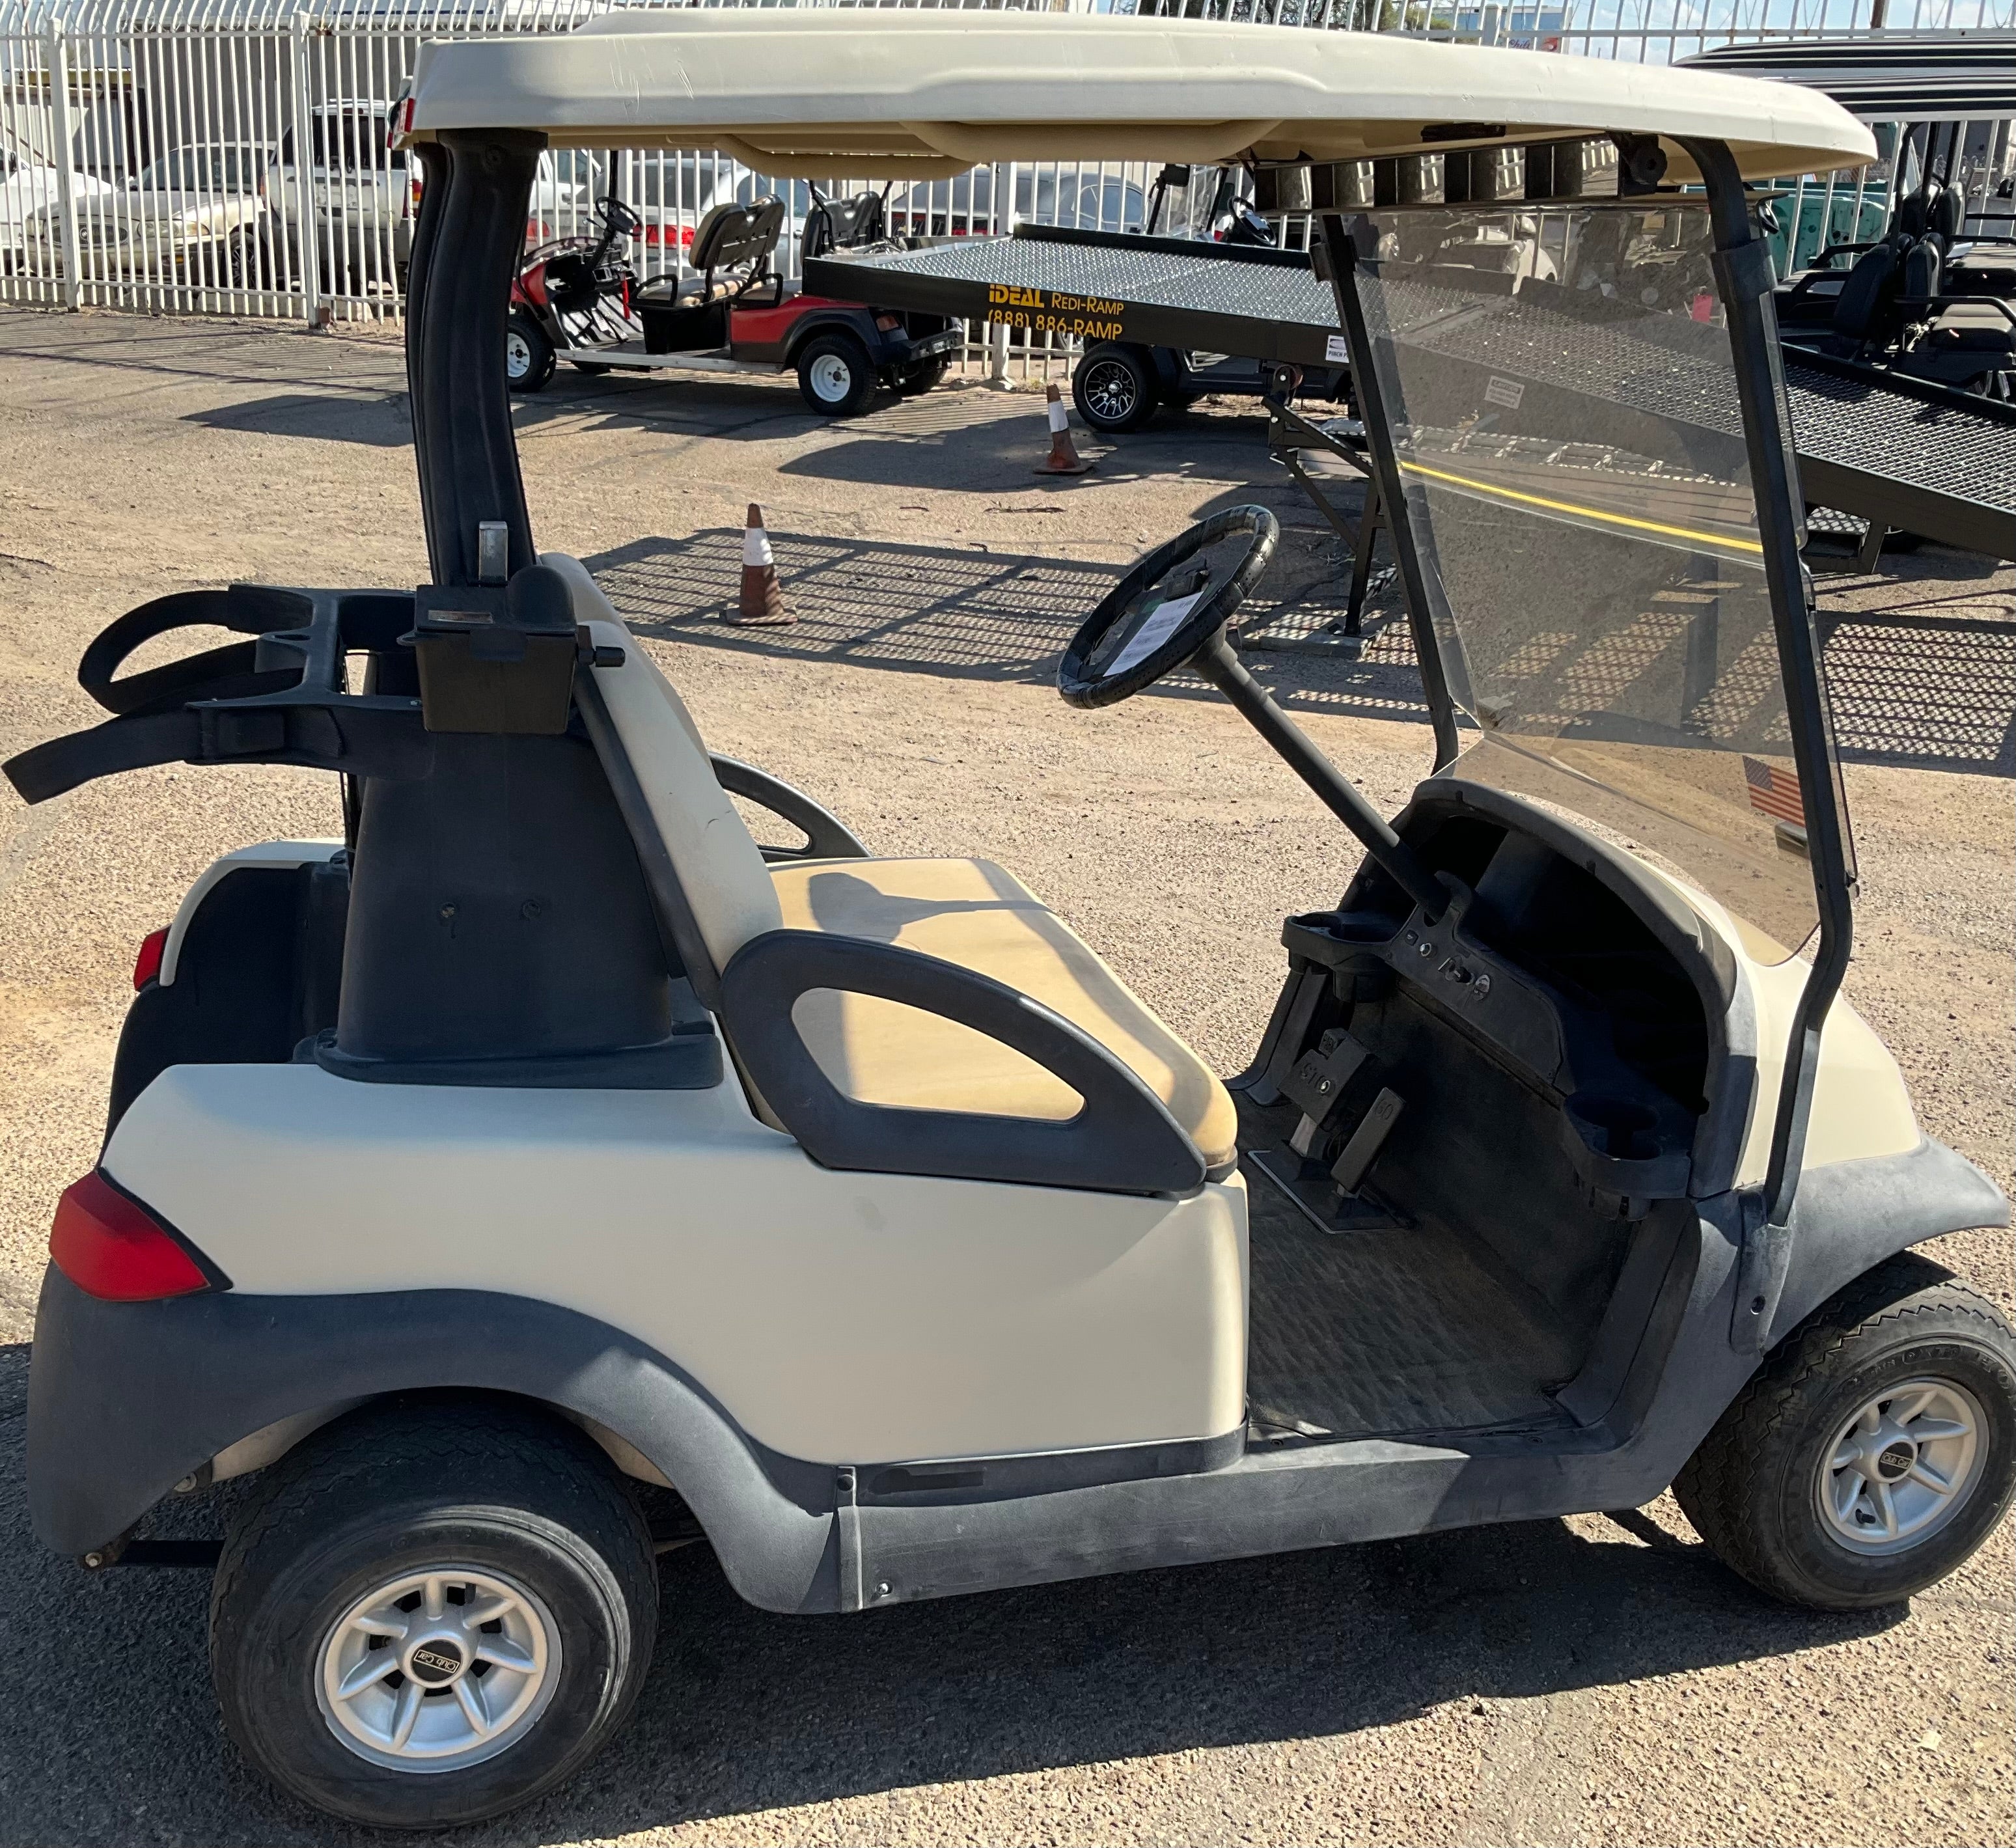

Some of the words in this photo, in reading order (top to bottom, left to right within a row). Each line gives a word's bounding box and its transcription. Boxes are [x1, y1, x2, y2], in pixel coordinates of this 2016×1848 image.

[1036, 314, 1123, 340] 886-RAMP
[417, 1652, 435, 1664] Car
[436, 1658, 456, 1671] Club
